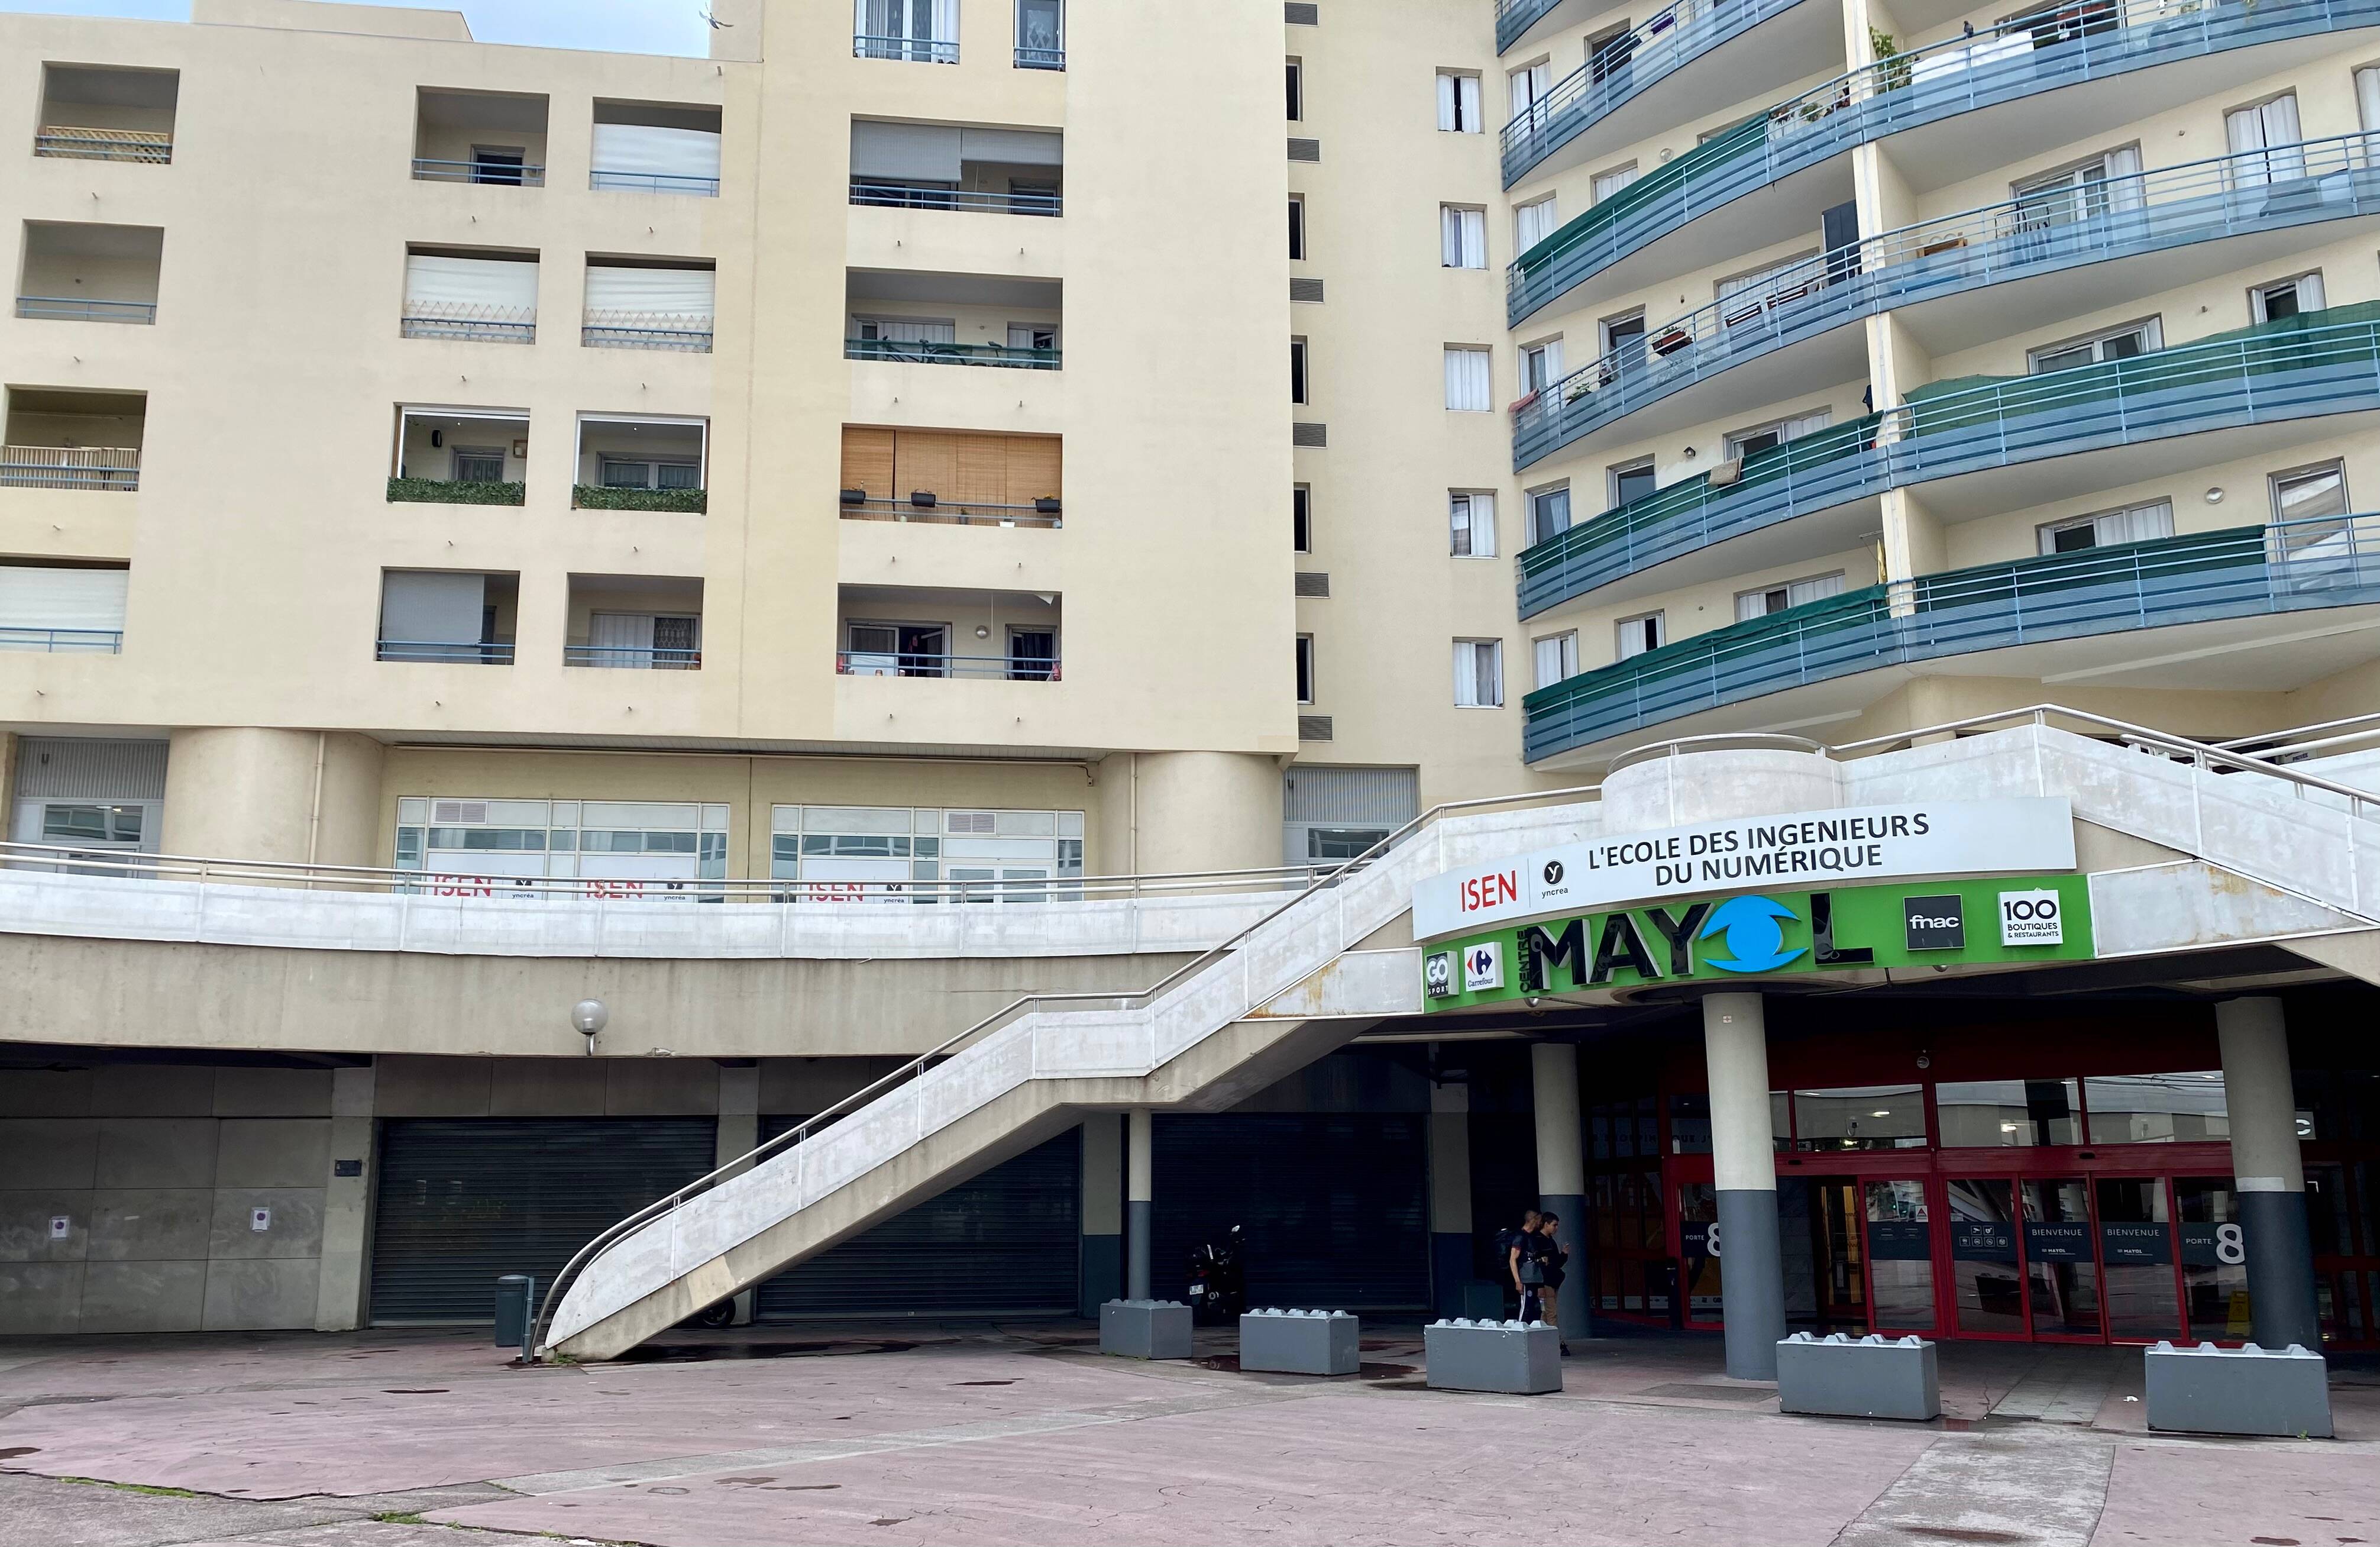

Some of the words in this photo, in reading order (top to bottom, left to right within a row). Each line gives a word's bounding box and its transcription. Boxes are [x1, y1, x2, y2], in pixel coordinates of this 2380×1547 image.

[1589, 837, 1680, 869] L'ECOLE
[1690, 831, 1738, 856] DES
[1749, 813, 1929, 849] INGENIEURS
[1655, 863, 1692, 886] DU
[1703, 844, 1883, 881] NUMÉRIQUE
[1461, 870, 1518, 912] ISEN
[1541, 887, 1569, 899] yncrea
[2004, 900, 2056, 921] 100
[1909, 915, 1959, 930] fnac
[2008, 923, 2058, 931] BOUTIQUES
[1427, 958, 1448, 983] GO
[1517, 929, 1529, 993] CENTRE
[1428, 985, 1448, 995] SPORT
[1468, 977, 1493, 987] Carrefour
[2107, 1229, 2160, 1237] BIENVENUE
[2216, 1223, 2245, 1264] 8
